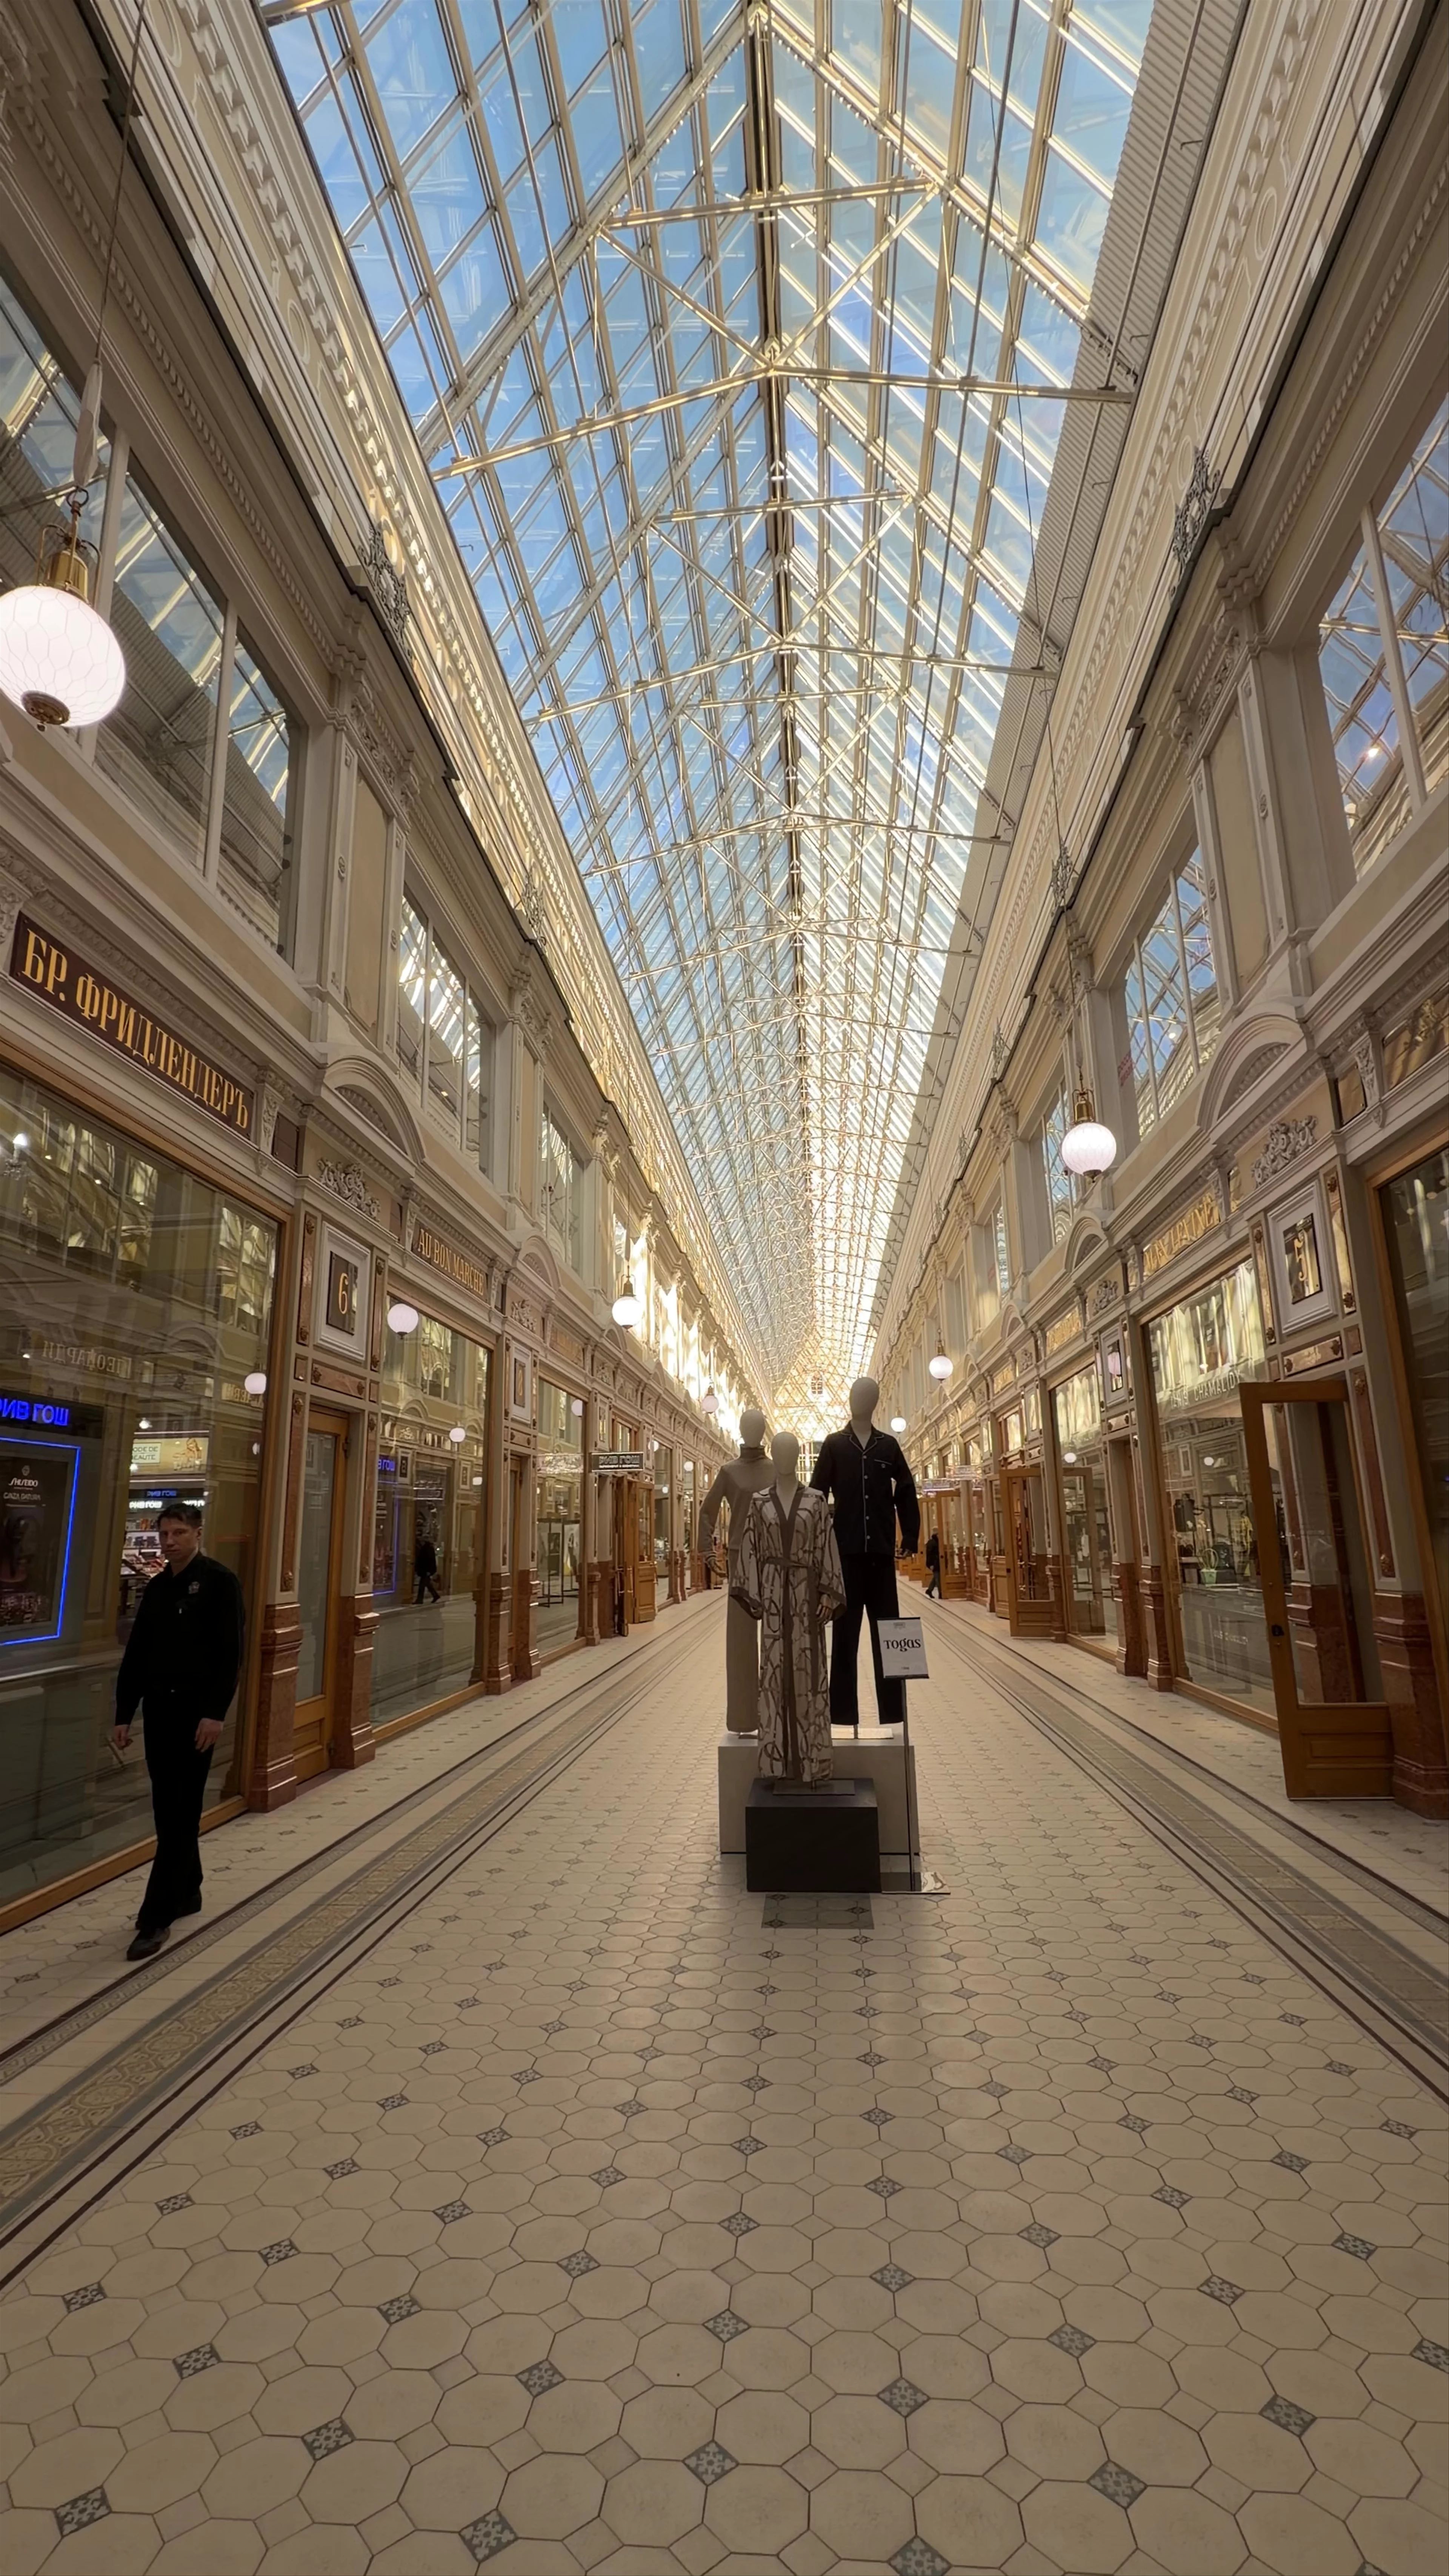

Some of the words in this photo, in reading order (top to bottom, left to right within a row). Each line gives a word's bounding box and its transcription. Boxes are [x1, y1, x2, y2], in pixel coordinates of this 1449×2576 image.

[22, 928, 68, 1001] БР.
[76, 973, 248, 1129] ФРИДЛЕНДЕРЪ
[417, 1229, 432, 1258] AU
[434, 1239, 452, 1273] BON
[1294, 1237, 1307, 1282] 5
[338, 1272, 349, 1315] 6
[0, 1397, 30, 1420] ИВ
[32, 1403, 69, 1426] ГОШ
